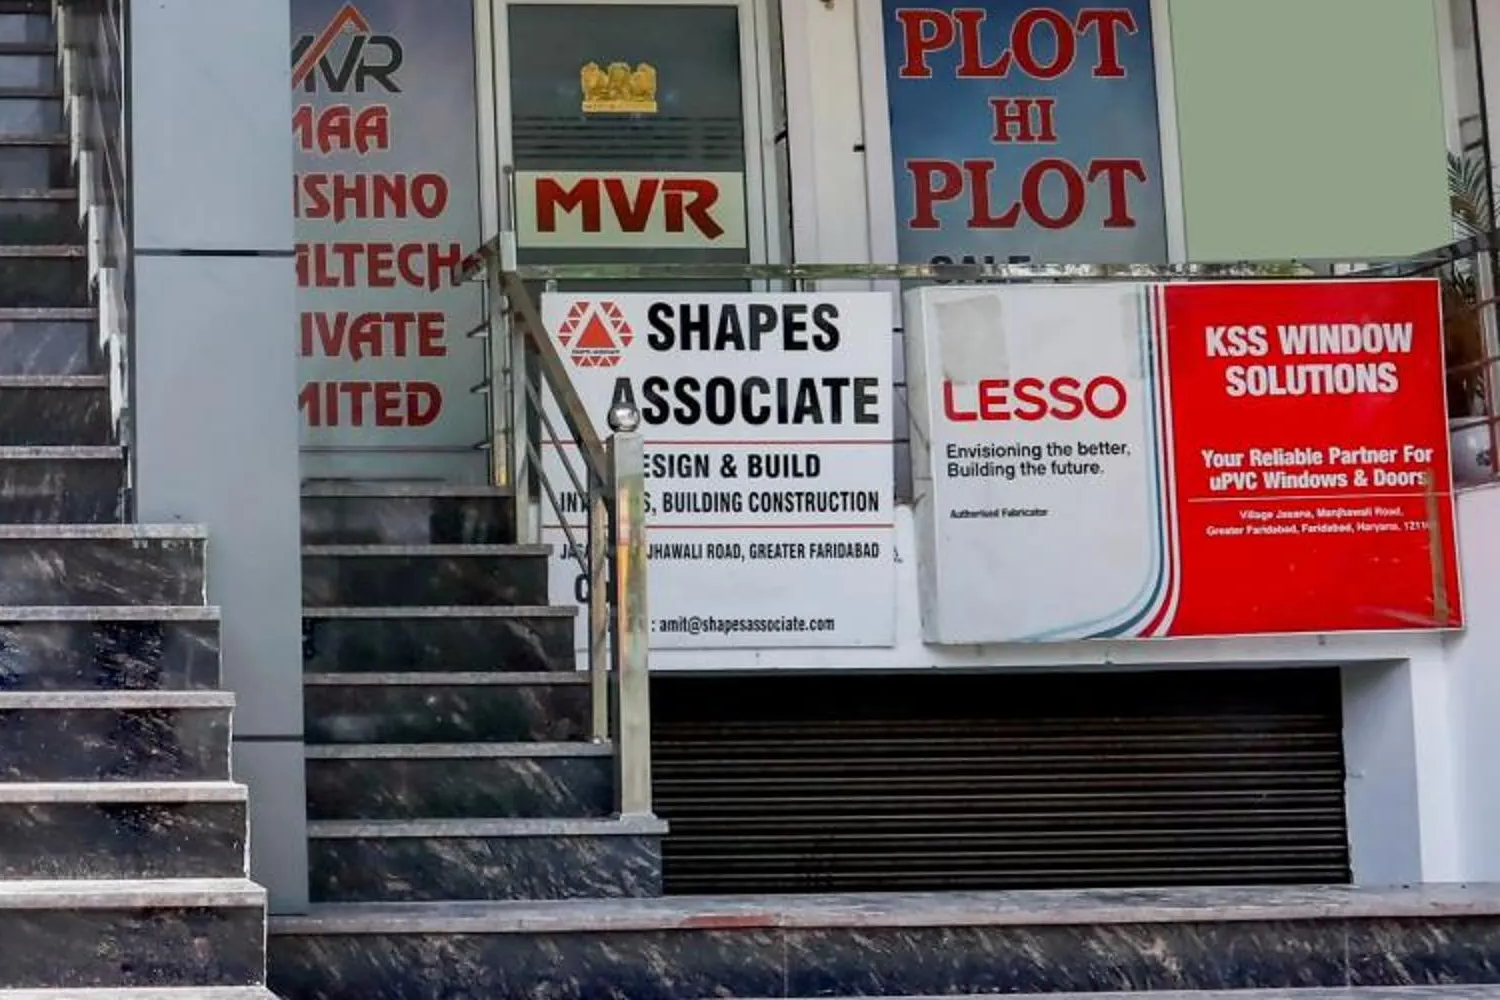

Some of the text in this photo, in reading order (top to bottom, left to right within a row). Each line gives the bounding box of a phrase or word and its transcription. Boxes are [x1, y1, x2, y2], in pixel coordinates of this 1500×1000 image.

[896, 7, 1139, 80] PLOT
[989, 97, 1059, 144] HI
[536, 178, 725, 240] MVR
[905, 157, 1148, 230] PLOT
[300, 311, 447, 361] IVATE
[647, 302, 840, 352] SHAPES
[1205, 323, 1413, 357] KSS WINDOW
[1225, 361, 1399, 396] SOLUTIONS
[943, 375, 1127, 421] LESSO
[720, 453, 738, 479] &
[748, 453, 821, 478] BUILD
[946, 441, 1132, 460] Envisioning the better,
[1201, 444, 1434, 468] Your Reliable Partner For
[947, 460, 1105, 480] Building the future.
[1209, 468, 1427, 491] uPVC Windows & Doors
[663, 491, 743, 513] BUILDING
[749, 491, 879, 513] CONSTRUCTION
[647, 542, 879, 562] JHAWALI ROAD, GREATER FARIDABAD
[659, 616, 835, 636] amit@shapesassociate.com
